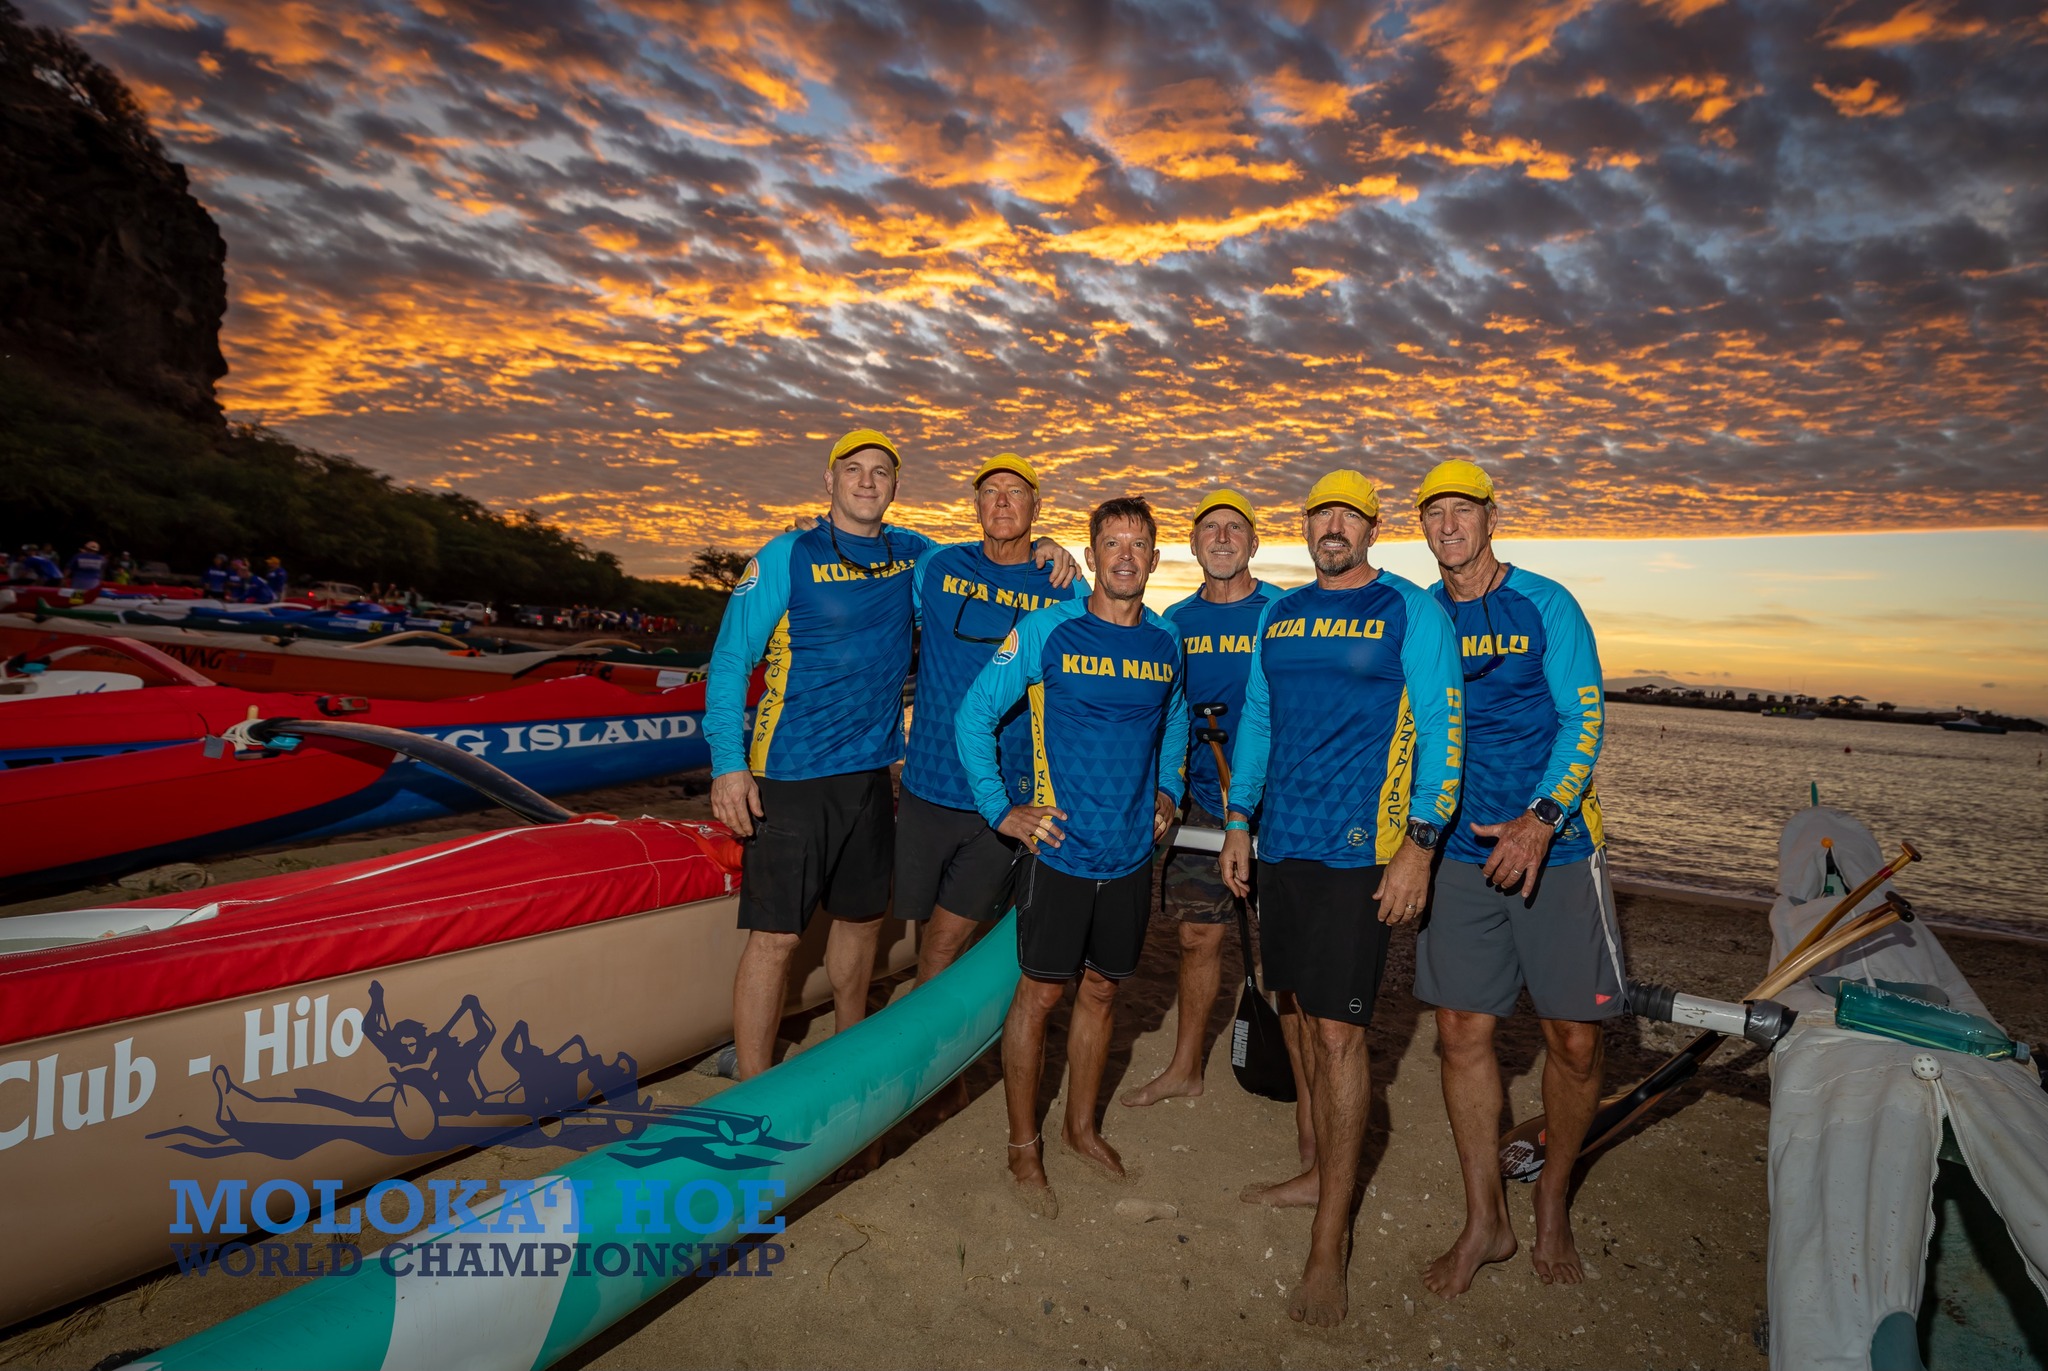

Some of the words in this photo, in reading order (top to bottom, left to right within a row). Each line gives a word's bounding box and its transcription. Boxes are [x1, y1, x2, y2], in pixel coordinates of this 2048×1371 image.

[811, 563, 868, 583] KUA
[869, 559, 916, 579] NAL
[942, 574, 989, 601] KUA
[1183, 635, 1214, 654] UA
[1311, 618, 1386, 639] NALU
[1461, 633, 1529, 657] NALU
[1062, 653, 1116, 677] KUA
[1122, 658, 1174, 682] NALU
[756, 687, 779, 742] SANTA
[1445, 687, 1462, 769] NALU
[501, 715, 697, 754] ISLAND
[1550, 762, 1591, 807] KUA
[1576, 685, 1602, 758] NALU
[1387, 777, 1401, 829] CRUZ
[0, 1036, 157, 1151] Club
[242, 994, 365, 1083] Hilo
